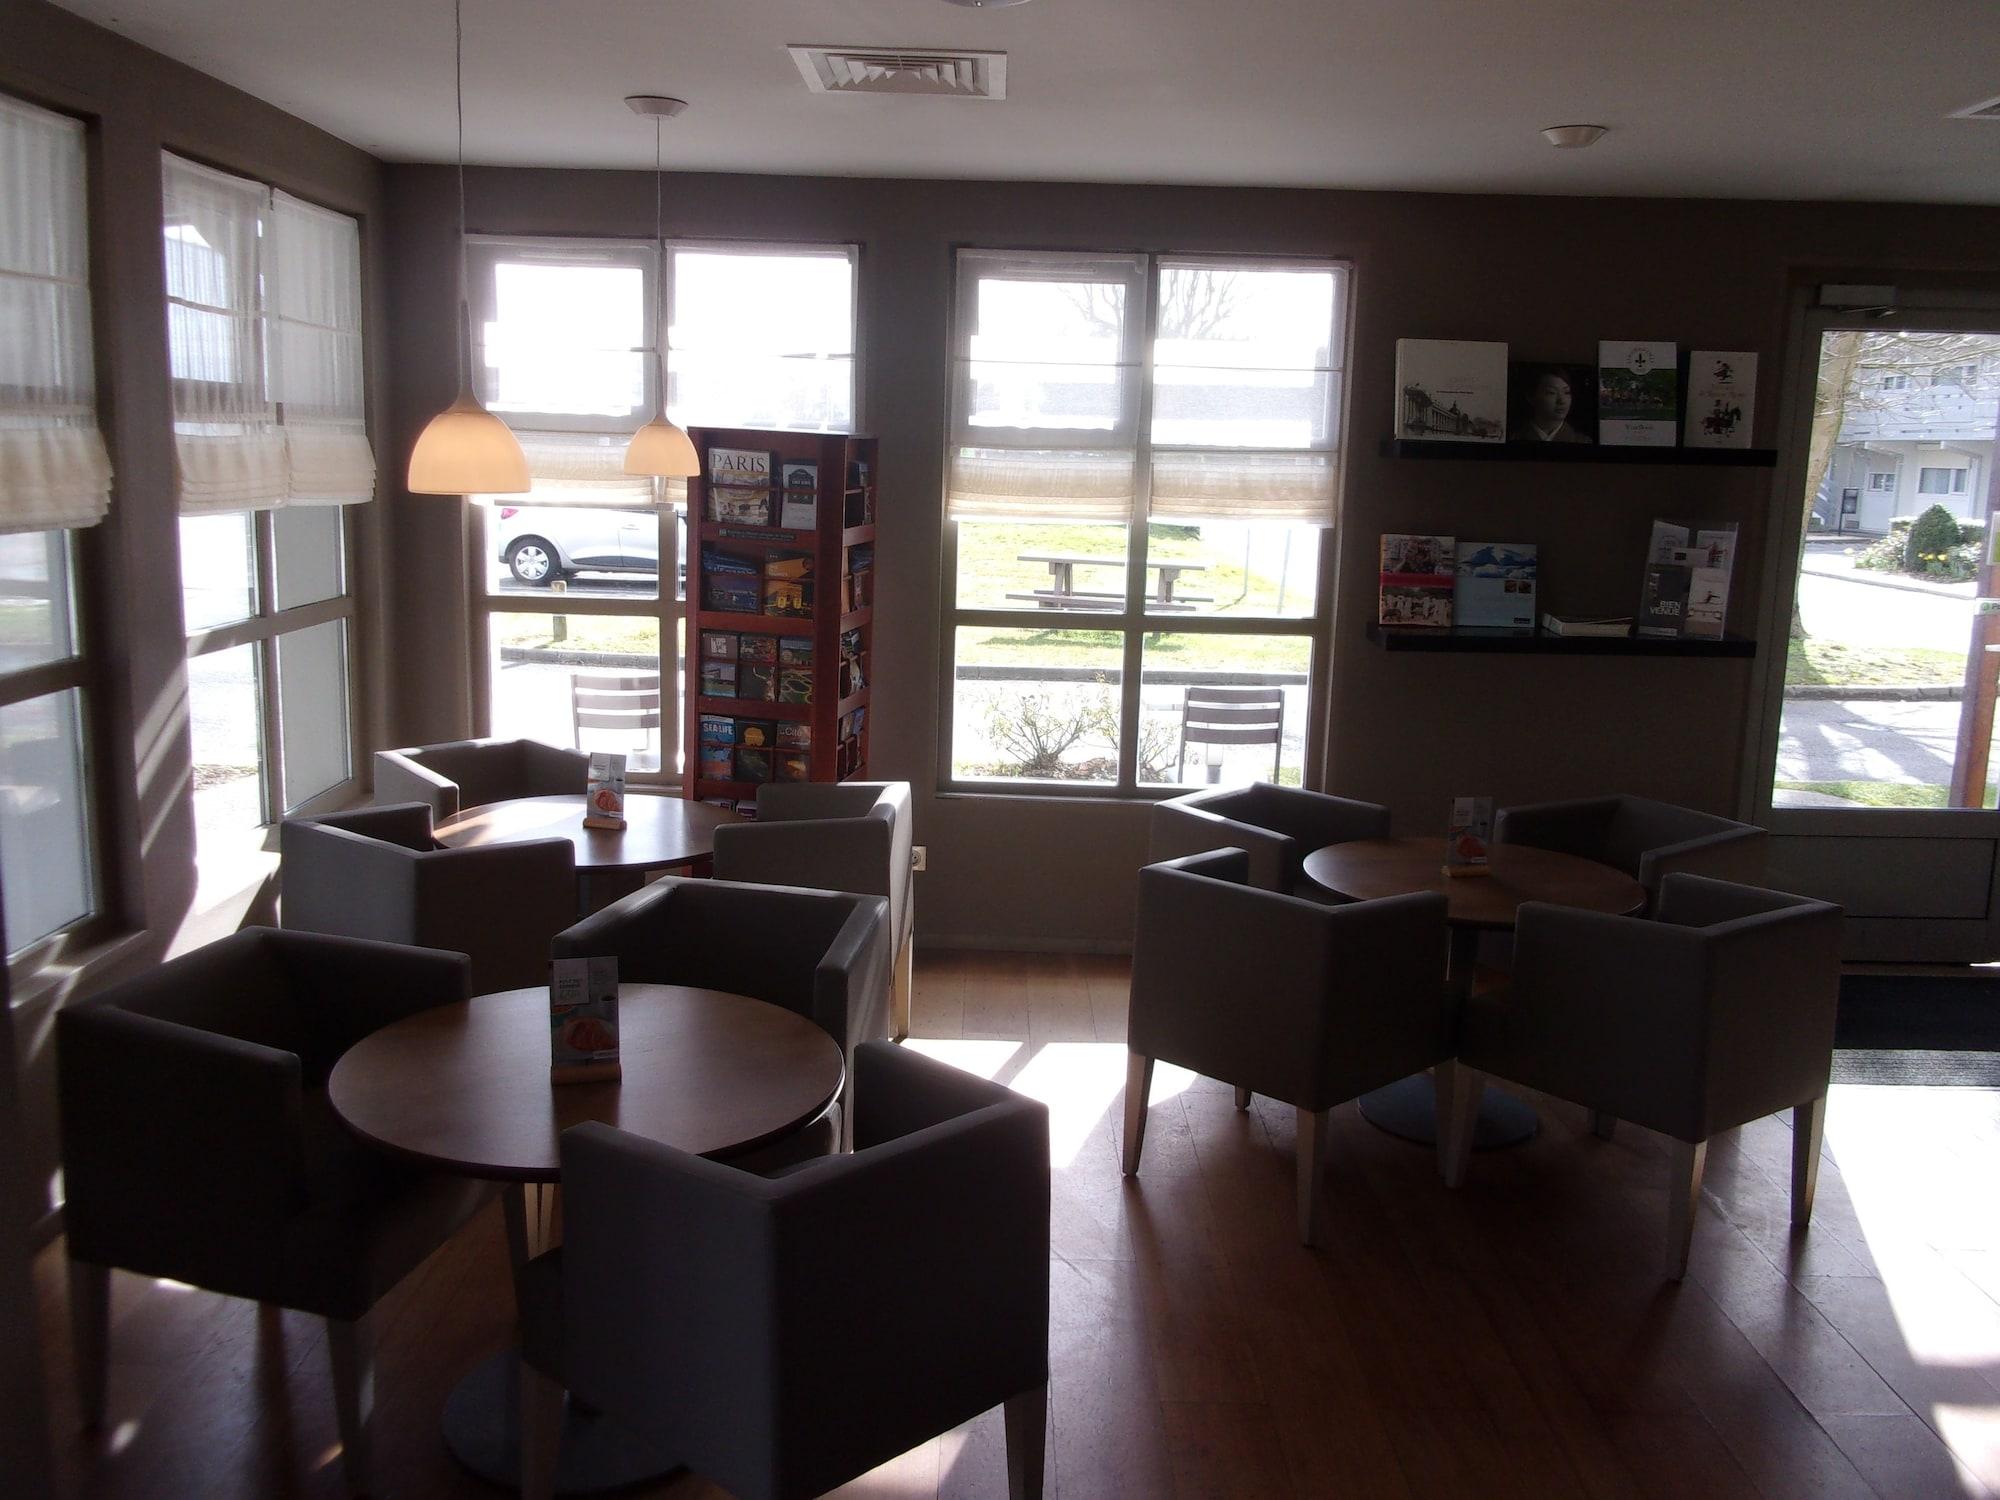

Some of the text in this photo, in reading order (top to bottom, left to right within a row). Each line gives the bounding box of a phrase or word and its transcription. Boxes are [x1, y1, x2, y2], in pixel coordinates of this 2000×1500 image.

[712, 453, 766, 474] PARIS
[1659, 600, 1681, 609] BIEN
[1649, 606, 1681, 616] VENUE
[703, 722, 734, 736] SEA LIFE
